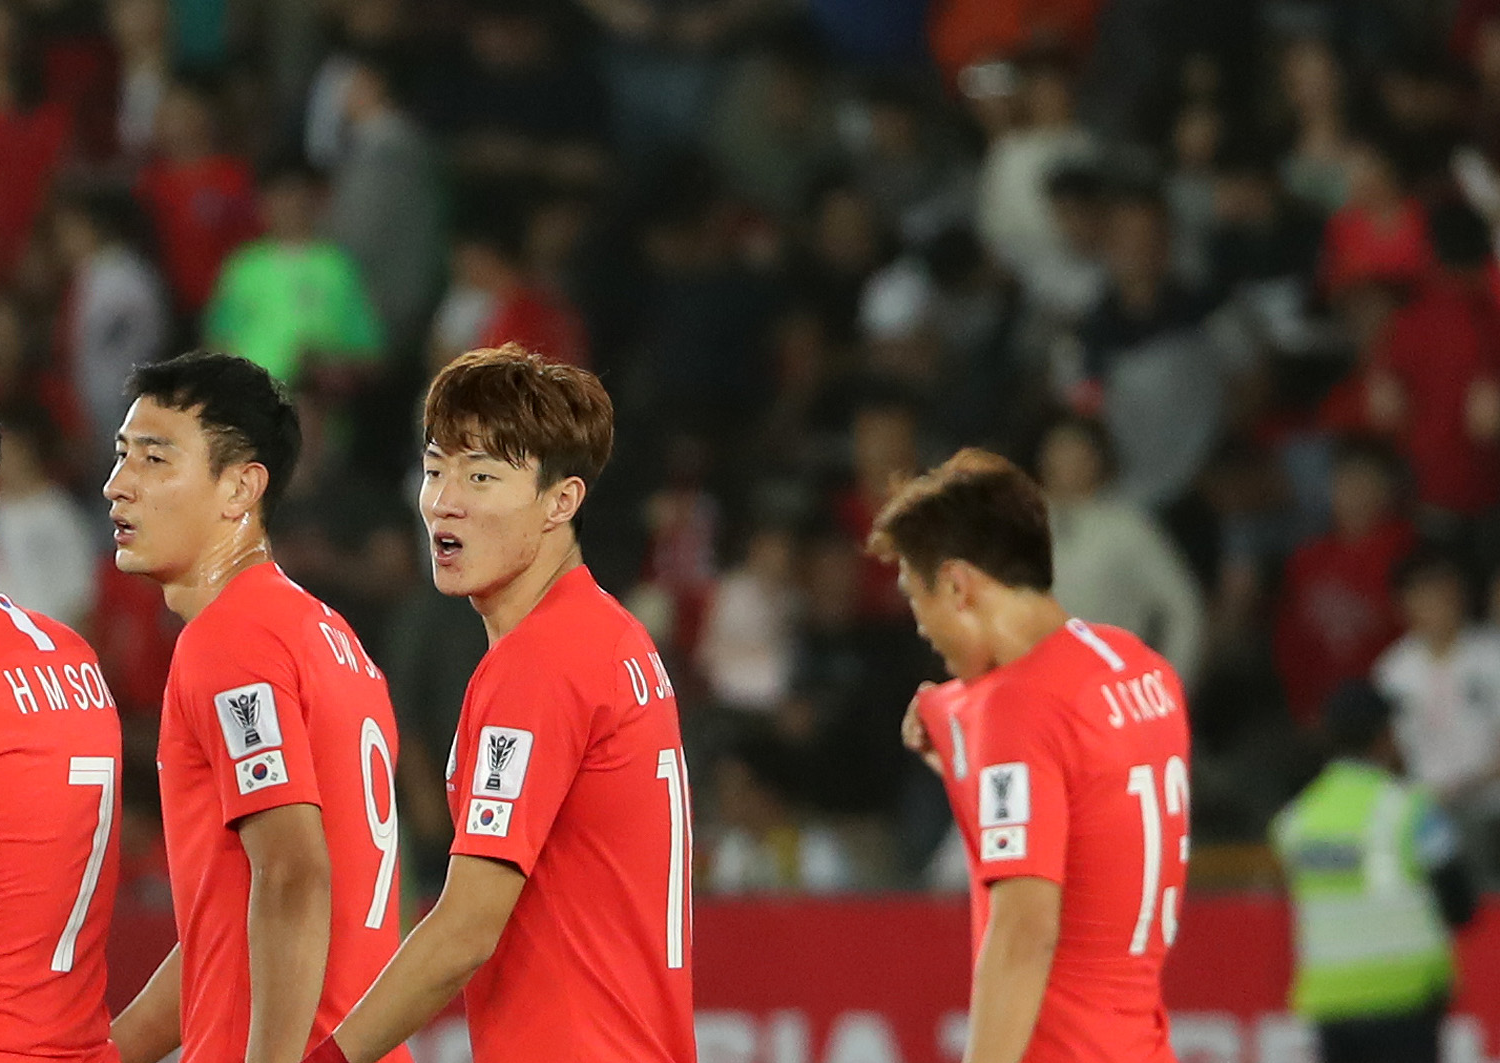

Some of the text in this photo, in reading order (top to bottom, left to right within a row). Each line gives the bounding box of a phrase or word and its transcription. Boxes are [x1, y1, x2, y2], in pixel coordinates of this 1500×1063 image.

[2, 667, 40, 715] H
[33, 664, 70, 711] M
[622, 656, 649, 706] U
[50, 756, 115, 973] 7
[360, 716, 399, 930] 9
[655, 746, 694, 970] 1
